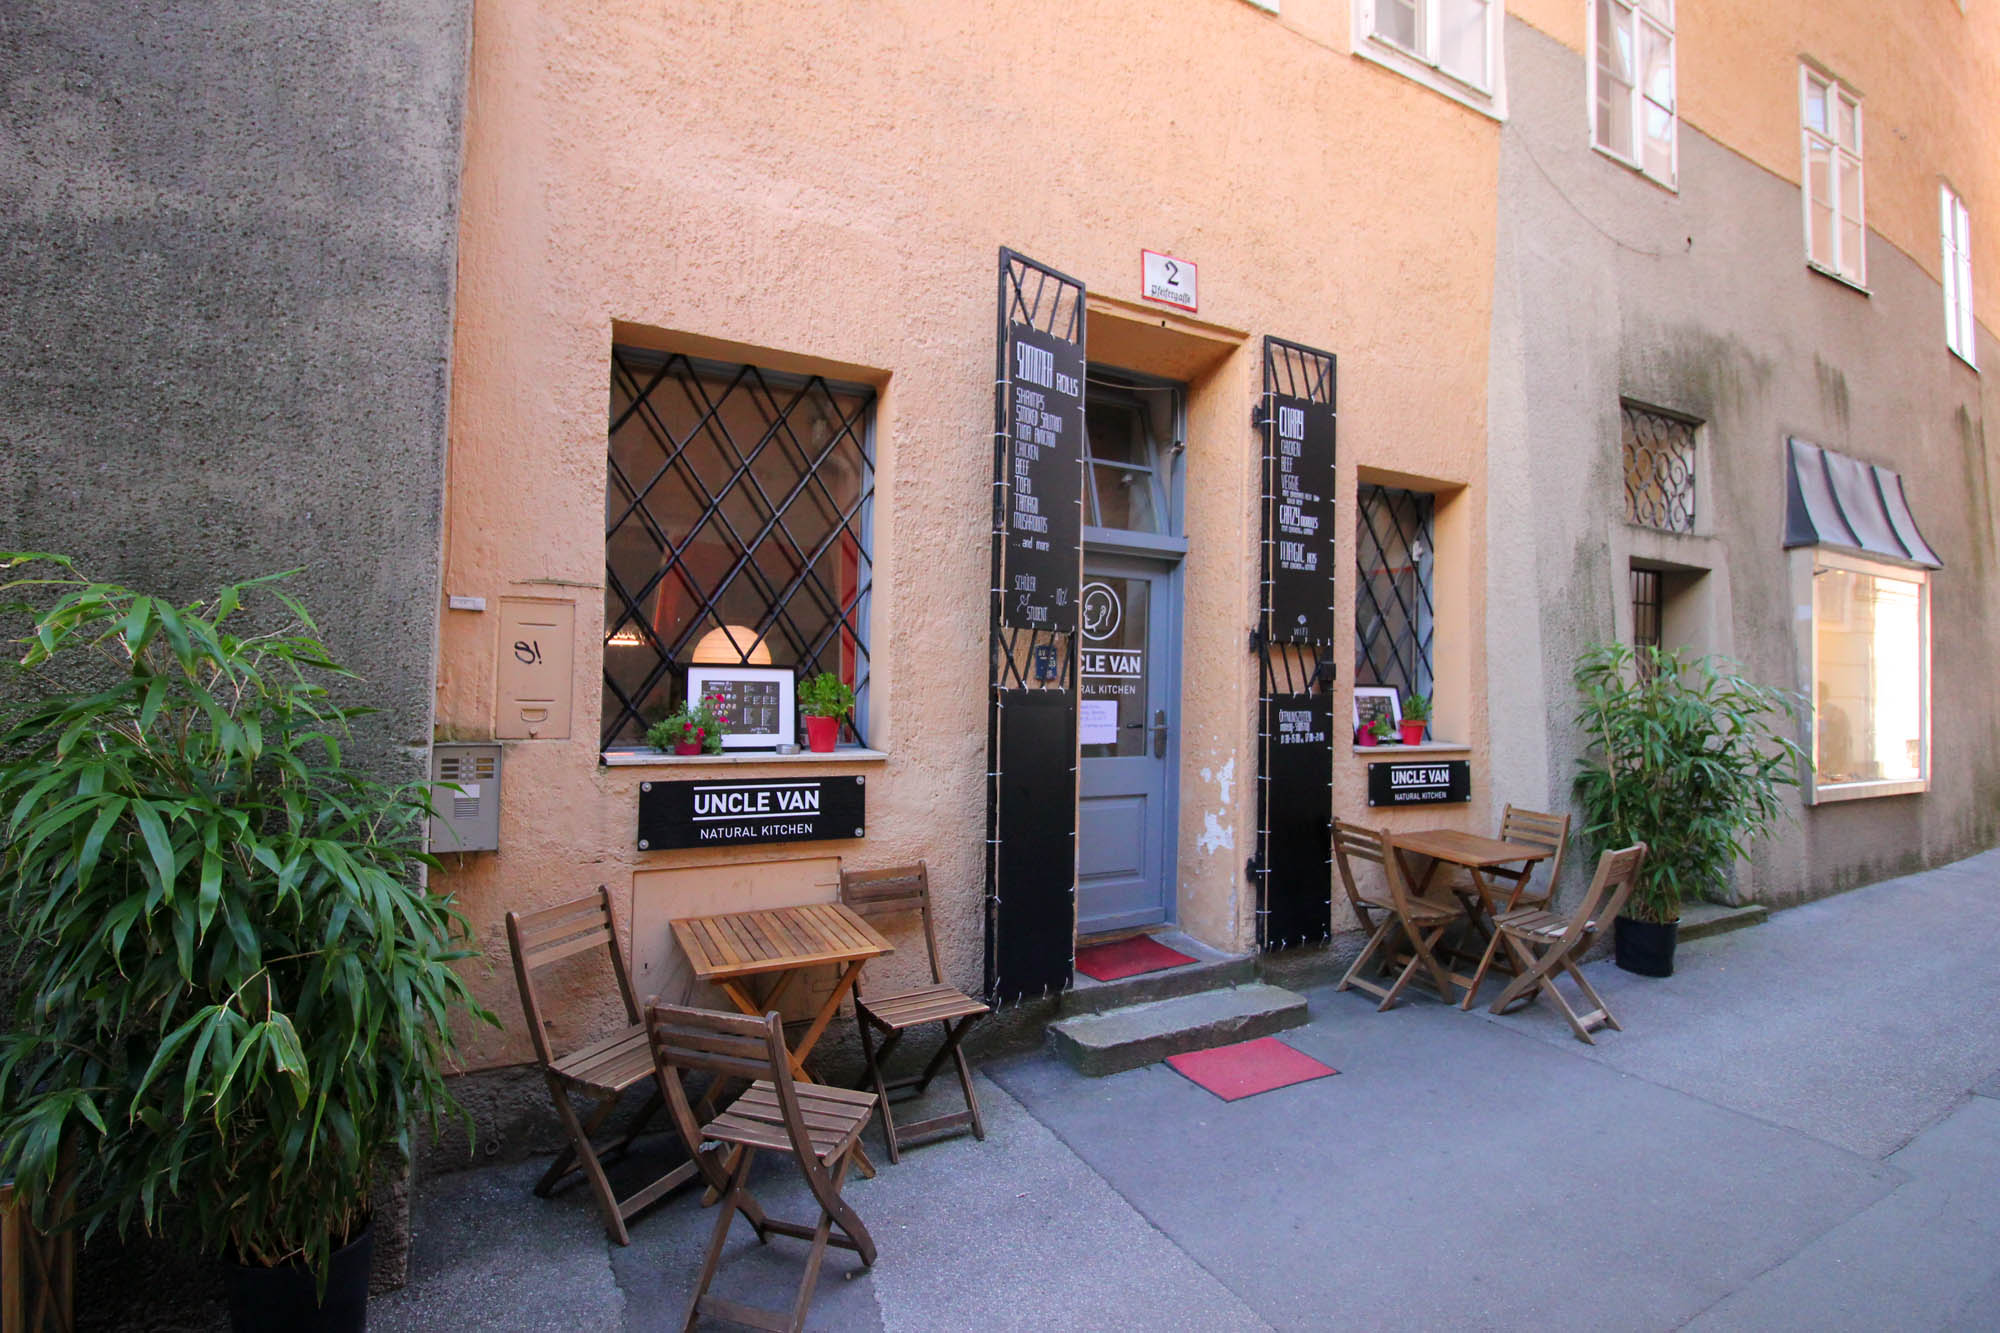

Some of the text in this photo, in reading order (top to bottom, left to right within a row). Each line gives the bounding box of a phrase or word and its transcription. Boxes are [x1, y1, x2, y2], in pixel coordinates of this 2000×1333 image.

[1165, 260, 1179, 286] 2
[1016, 341, 1078, 397] SUMMER ROLLS
[1280, 406, 1304, 440] CURRY
[1016, 458, 1029, 476] BEEF
[1281, 456, 1293, 472] BEEF
[1014, 475, 1031, 494] TOFU
[1280, 540, 1305, 562] MAGIC
[1110, 656, 1141, 673] VAN
[1098, 685, 1136, 695] KITCHEN
[1391, 769, 1450, 784] UNCLE VAN
[694, 790, 819, 815] UNCLE VAN
[1422, 792, 1447, 800] KITCHEN
[700, 824, 813, 840] NATURAL KITCHEN
